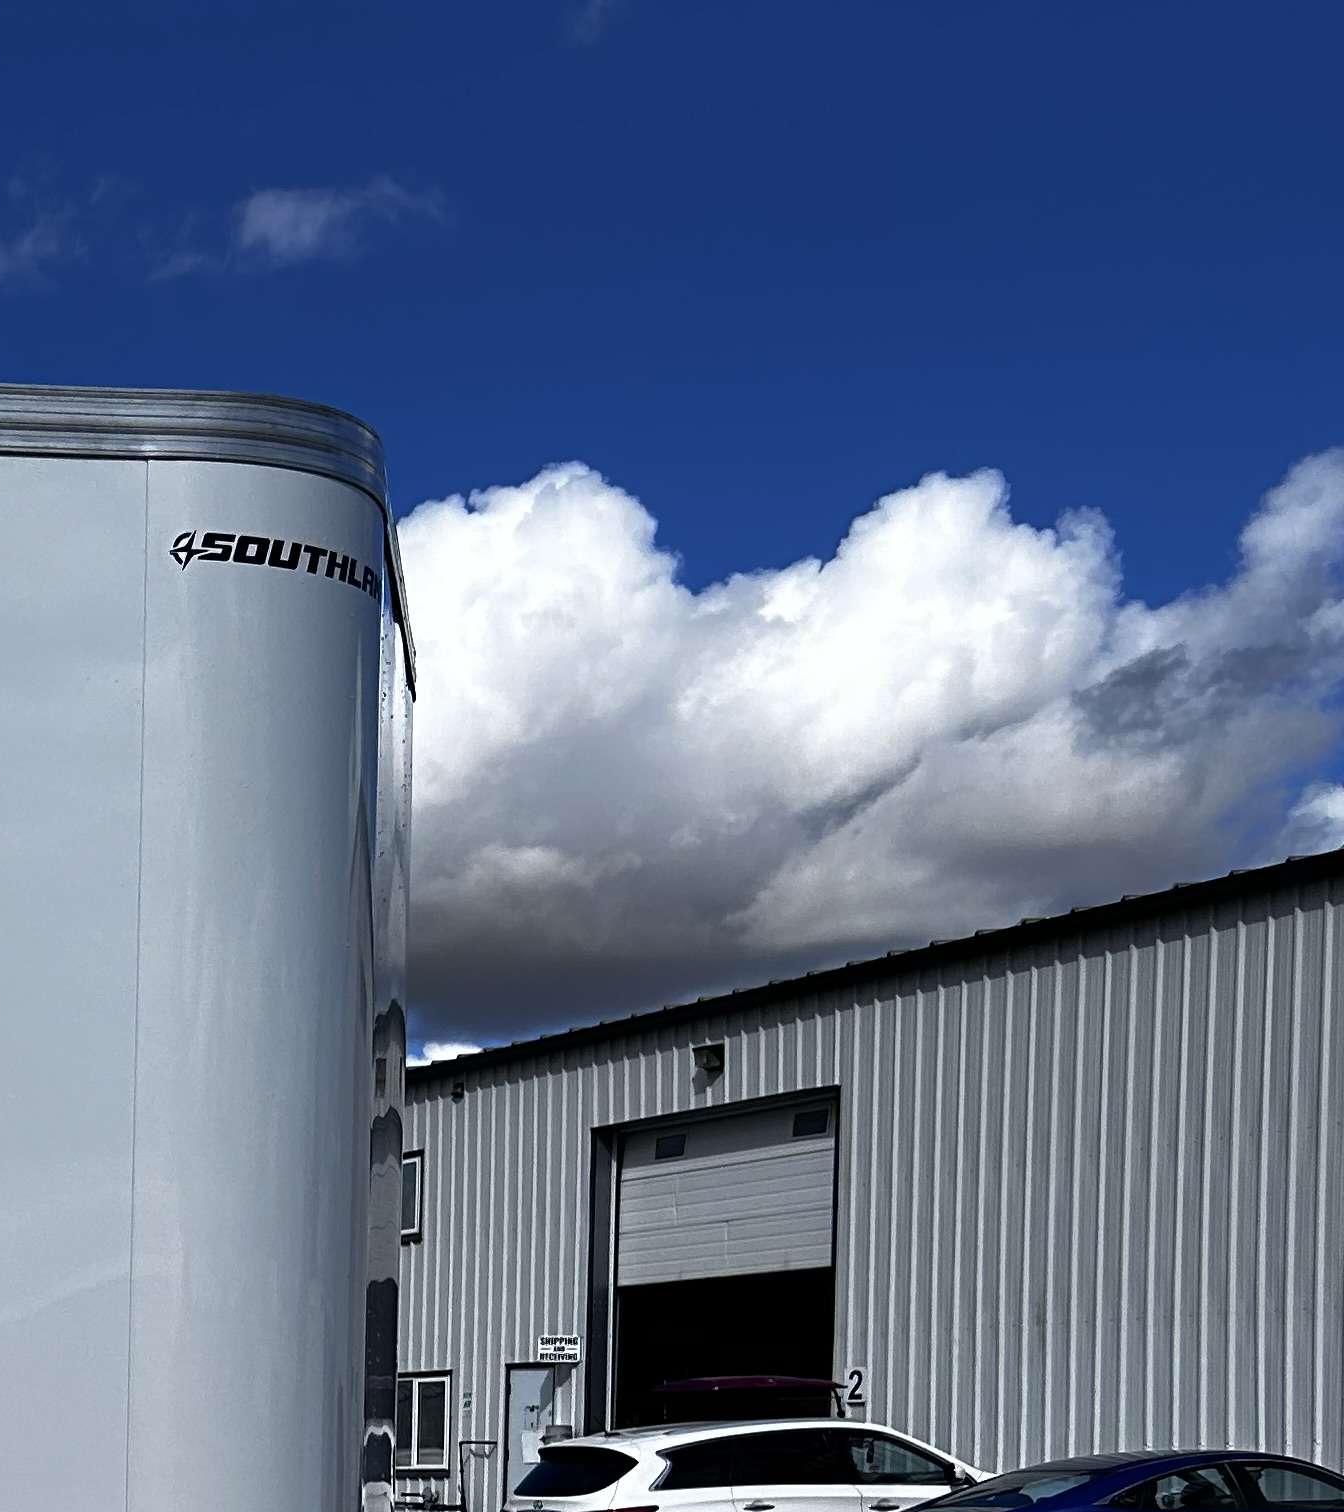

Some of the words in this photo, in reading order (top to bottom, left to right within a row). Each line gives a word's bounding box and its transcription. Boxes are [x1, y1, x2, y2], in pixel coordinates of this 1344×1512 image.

[540, 1337, 578, 1346] SHIPPING
[539, 1353, 578, 1361] RECEIVING
[848, 1370, 863, 1400] 2
